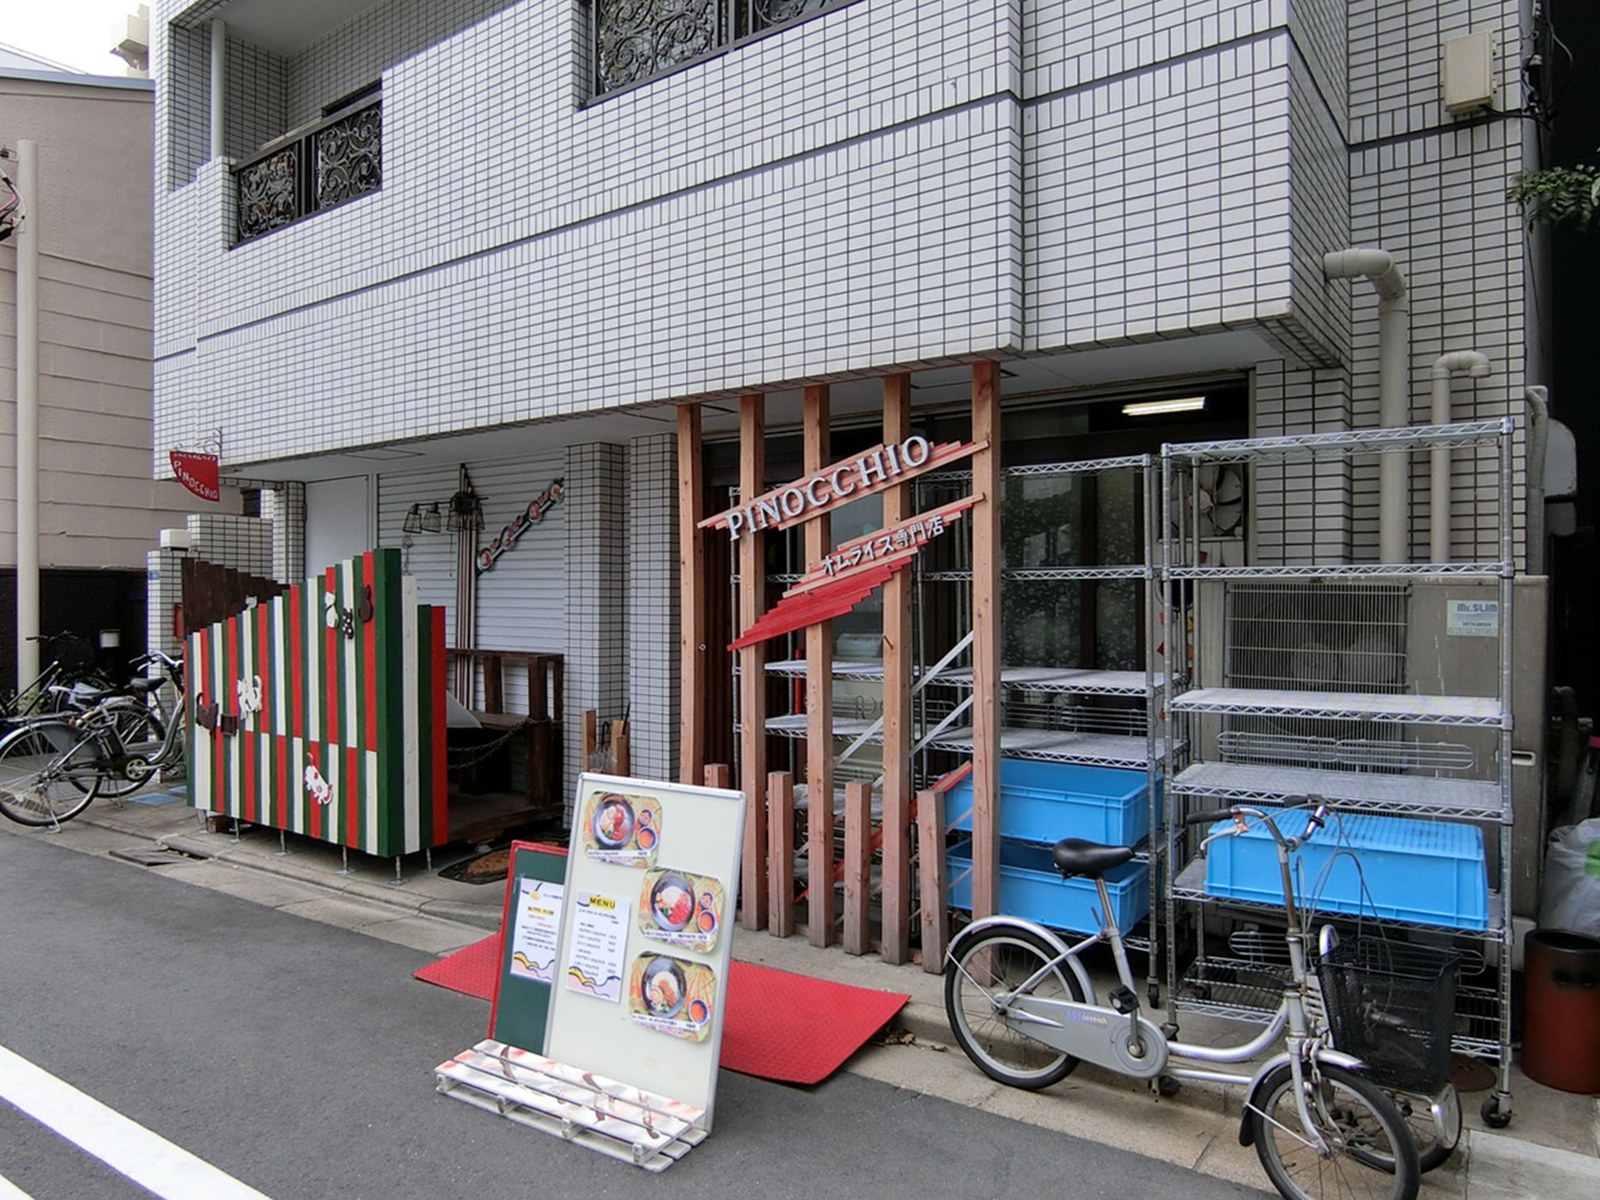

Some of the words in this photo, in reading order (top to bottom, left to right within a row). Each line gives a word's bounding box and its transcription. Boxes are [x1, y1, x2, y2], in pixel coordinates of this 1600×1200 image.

[173, 460, 219, 500] PINOCCHIO
[726, 435, 930, 541] PINOCCHIO
[821, 515, 945, 577] オムライス専門店
[589, 897, 616, 909] MENU
